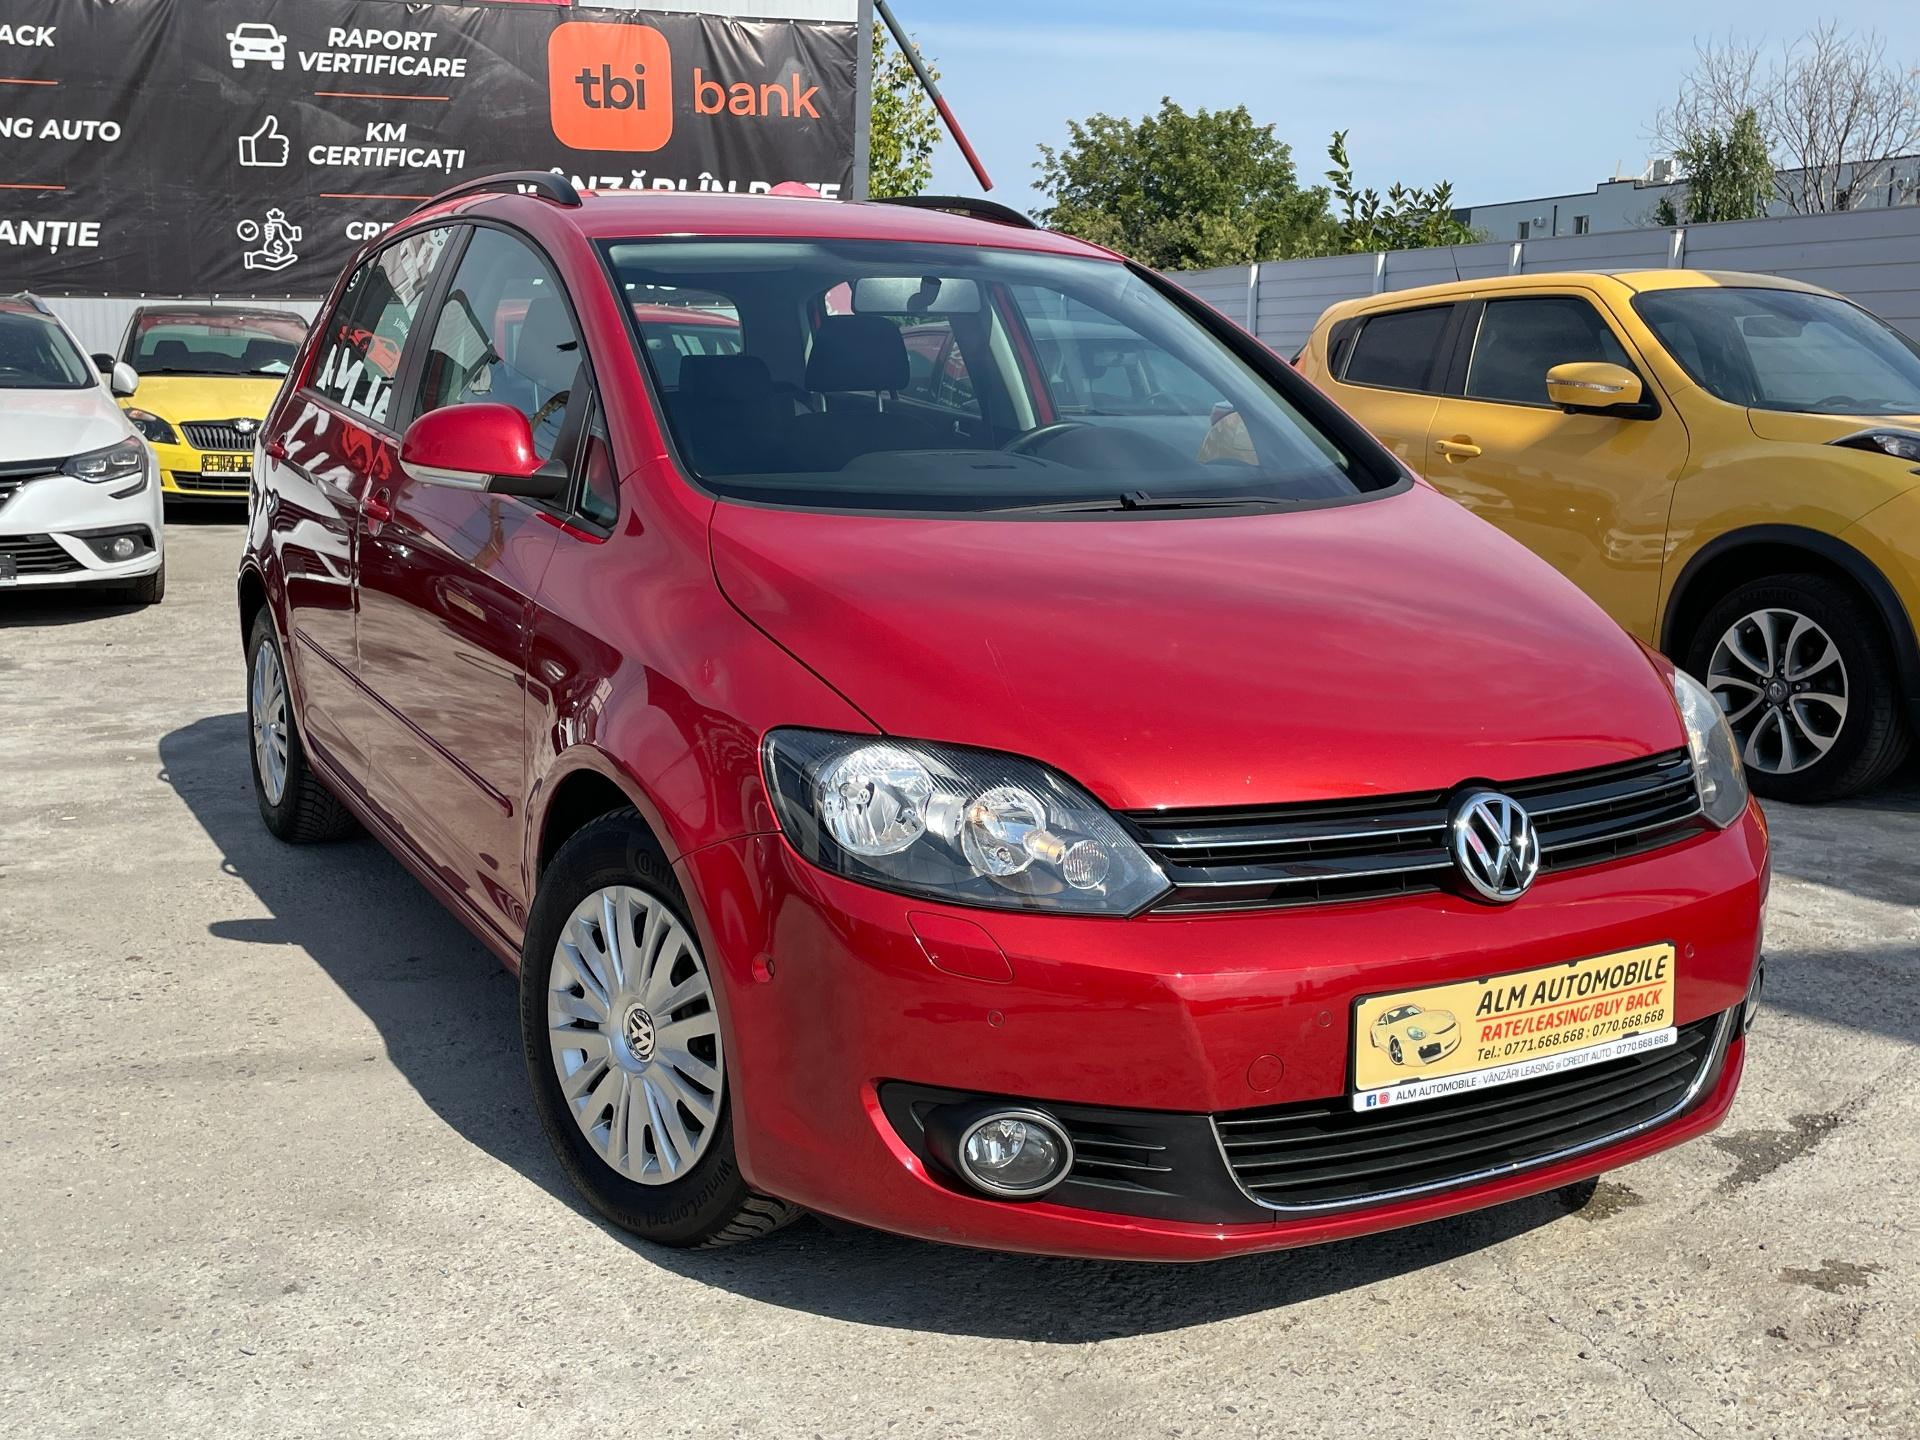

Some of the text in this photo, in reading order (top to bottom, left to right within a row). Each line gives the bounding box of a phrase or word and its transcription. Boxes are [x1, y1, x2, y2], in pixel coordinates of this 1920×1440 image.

[328, 27, 437, 51] RAPORT
[298, 50, 467, 78] VERTIFICARE
[575, 63, 820, 119] tbi bank
[39, 119, 121, 142] AUTO
[365, 122, 407, 143] KM
[308, 145, 466, 174] CERTIFICAȚI
[1475, 955, 1668, 1016] ALM AUTOMOBILE
[1477, 1046, 1502, 1061] Tel.:
[1504, 1027, 1584, 1056] 0771.668.668
[1592, 1009, 1665, 1037] 0770.668.668
[1480, 989, 1663, 1043] RATE/LEASING/BUY BACK
[1396, 1090, 1417, 1101] ALM
[1418, 1077, 1477, 1097] AUTOMOBILE
[1520, 1061, 1554, 1078] LEASING
[1562, 1052, 1590, 1068] CREDIT
[1590, 1047, 1612, 1063] AUTO
[1616, 1033, 1669, 1055] 0770.668.668
